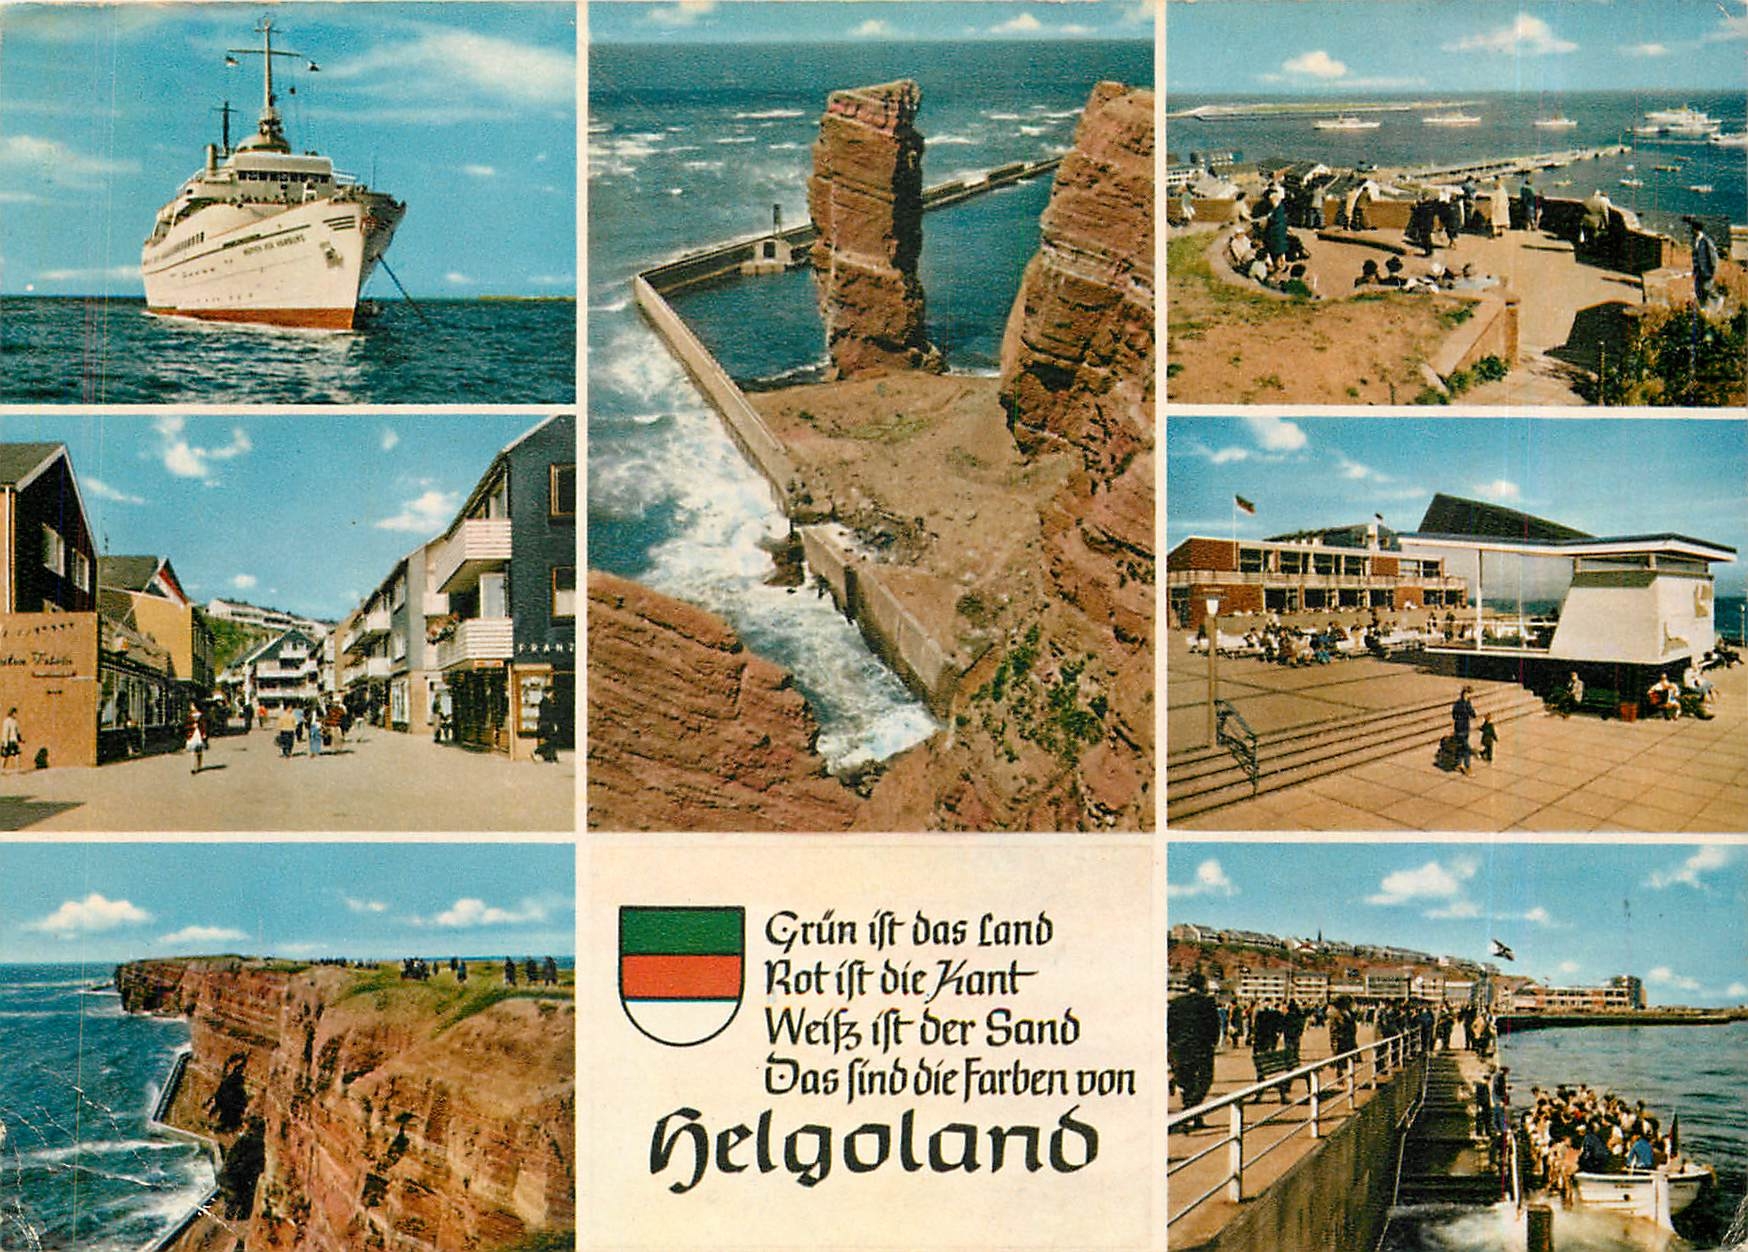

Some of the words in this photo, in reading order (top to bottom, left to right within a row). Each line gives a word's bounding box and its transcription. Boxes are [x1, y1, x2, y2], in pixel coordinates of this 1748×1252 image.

[765, 910, 857, 954] Grün
[912, 910, 968, 947] das
[978, 911, 1053, 947] Land
[764, 959, 831, 996] Rot
[880, 959, 927, 996] die
[925, 959, 1037, 1005] Kant
[920, 1007, 976, 1046] der
[986, 1007, 1080, 1047] Sand
[765, 1051, 840, 1096] Das
[913, 1057, 959, 1097] die
[963, 1057, 1069, 1103] Farben
[1076, 1069, 1136, 1097] von
[650, 1104, 1099, 1194] Helgoland
